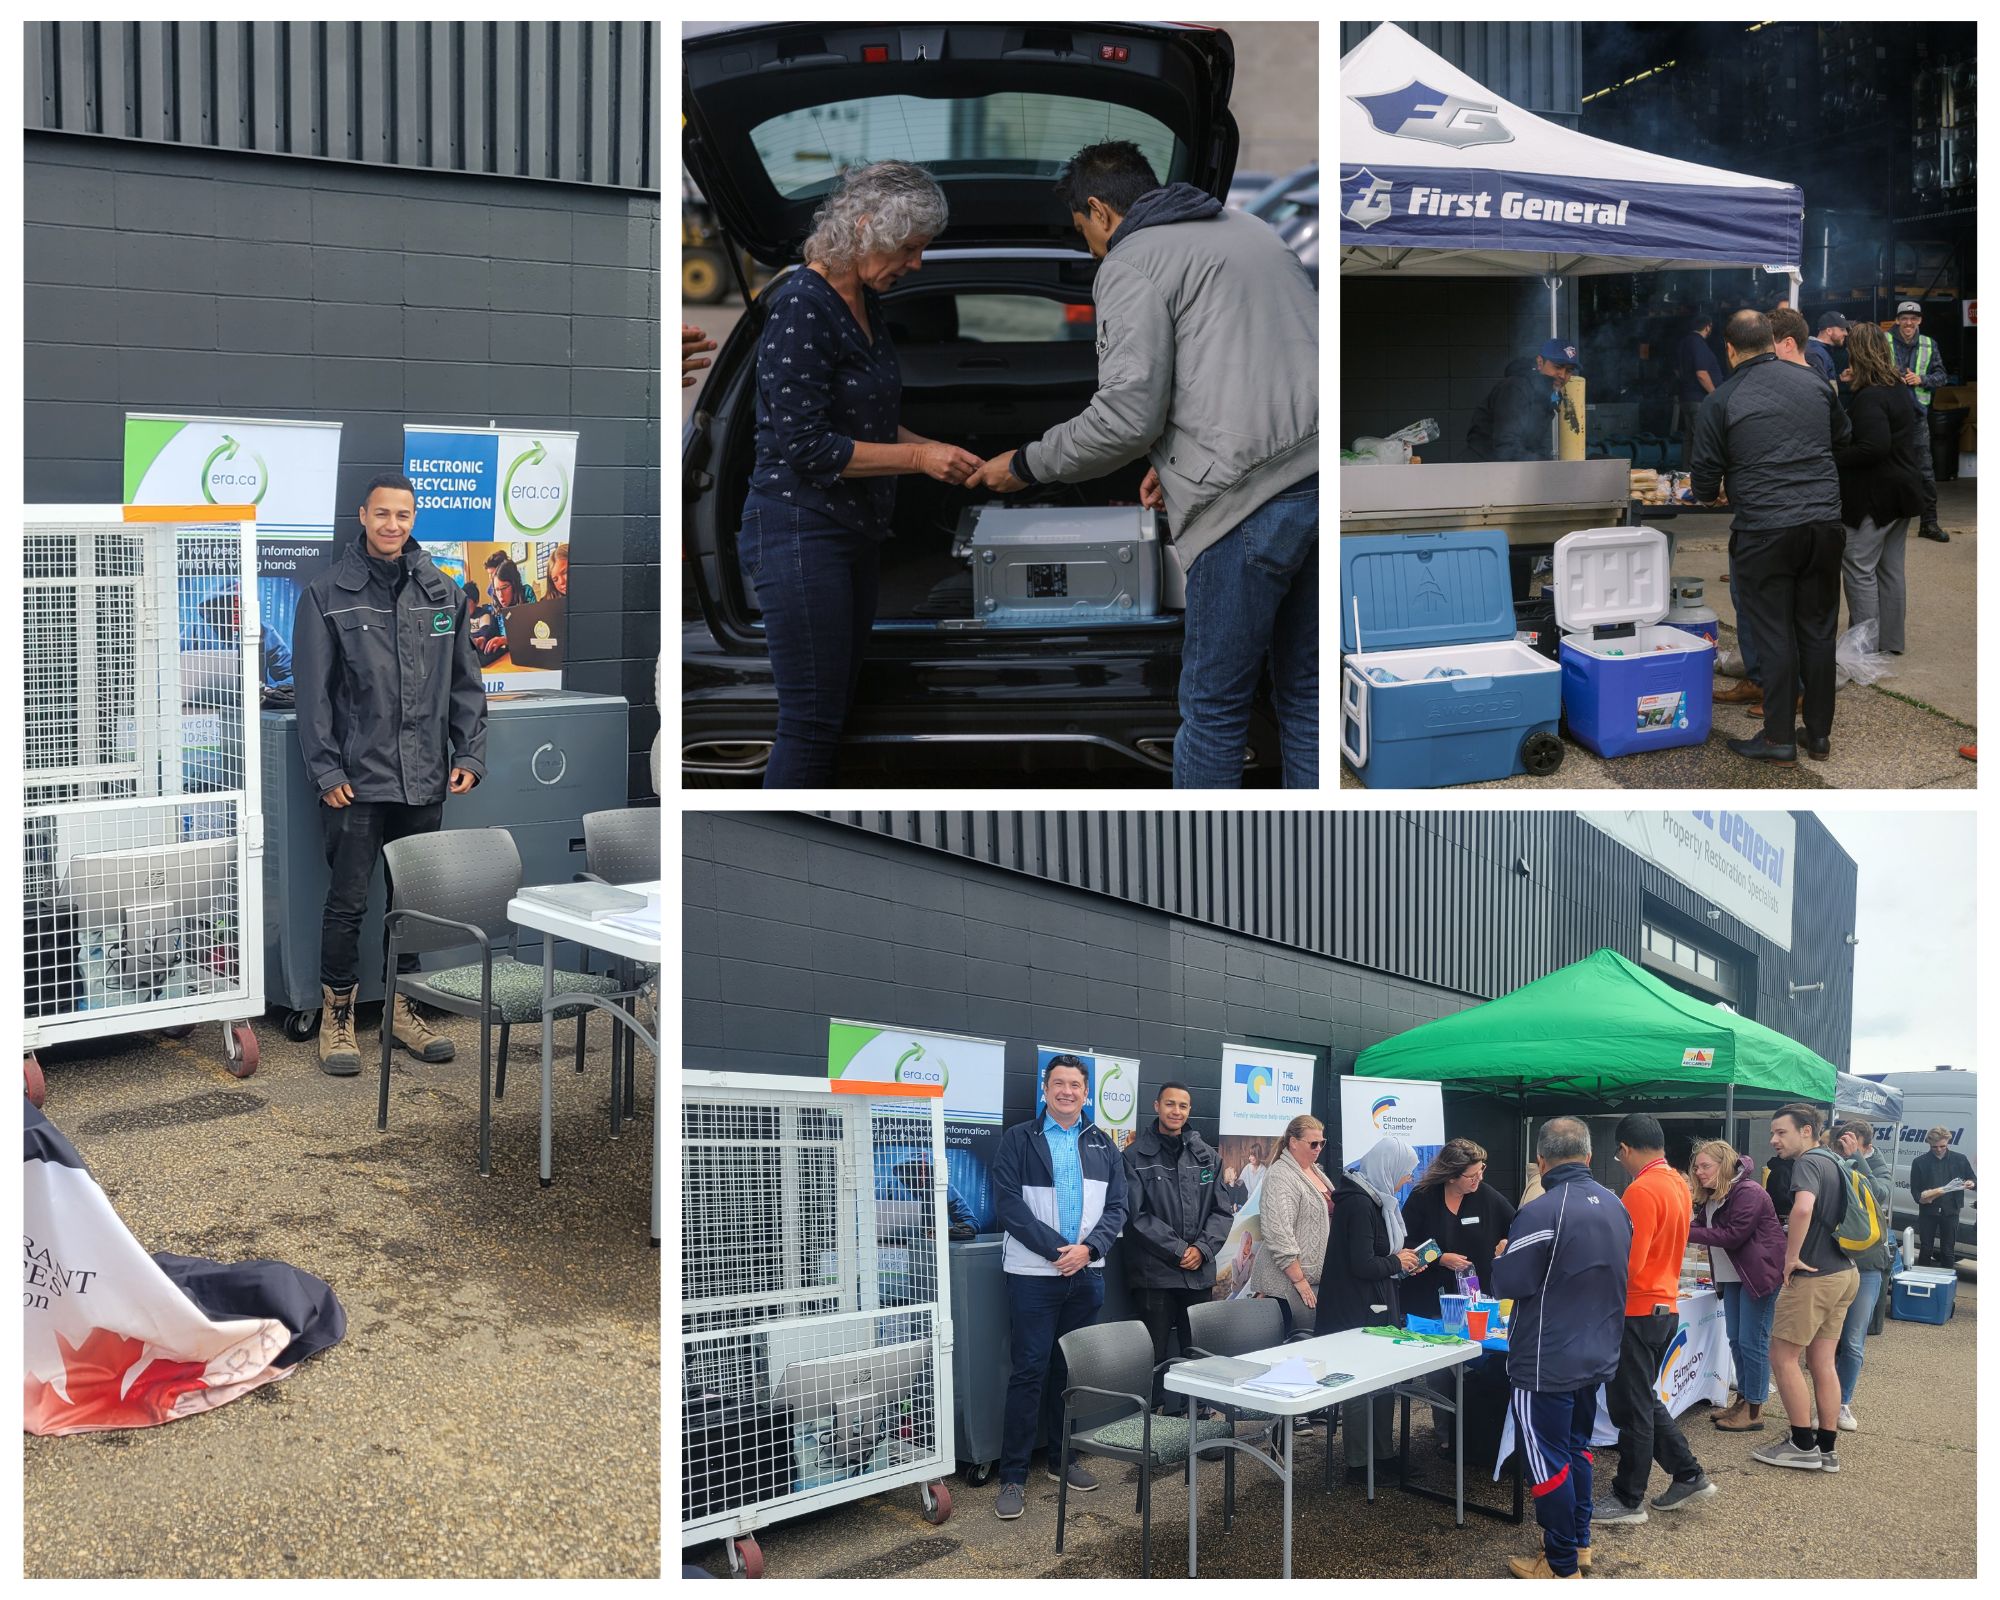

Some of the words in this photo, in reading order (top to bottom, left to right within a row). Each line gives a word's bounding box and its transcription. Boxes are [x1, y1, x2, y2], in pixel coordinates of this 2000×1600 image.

[1407, 186, 1492, 218] First
[1500, 191, 1631, 226] General
[409, 459, 484, 474] ELECTRONIC
[211, 473, 257, 486] era.ca
[410, 477, 478, 492] RECYCLING
[511, 485, 561, 500] era.ca
[415, 496, 492, 510] SSOCIATION
[261, 545, 320, 557] information
[264, 559, 297, 570] hands
[1719, 811, 1785, 888] General
[1662, 811, 1703, 860] Property
[1704, 840, 1747, 892] Restoration
[1748, 873, 1779, 914] Specialists
[903, 1069, 940, 1082] era.ca
[1282, 1071, 1294, 1080] THE
[1282, 1084, 1301, 1093] TODAY
[1103, 1091, 1131, 1103] era.ca
[1281, 1096, 1304, 1105] CENTRE
[944, 1125, 991, 1136] information
[1383, 1123, 1414, 1131] Chamber
[946, 1135, 972, 1145] hands
